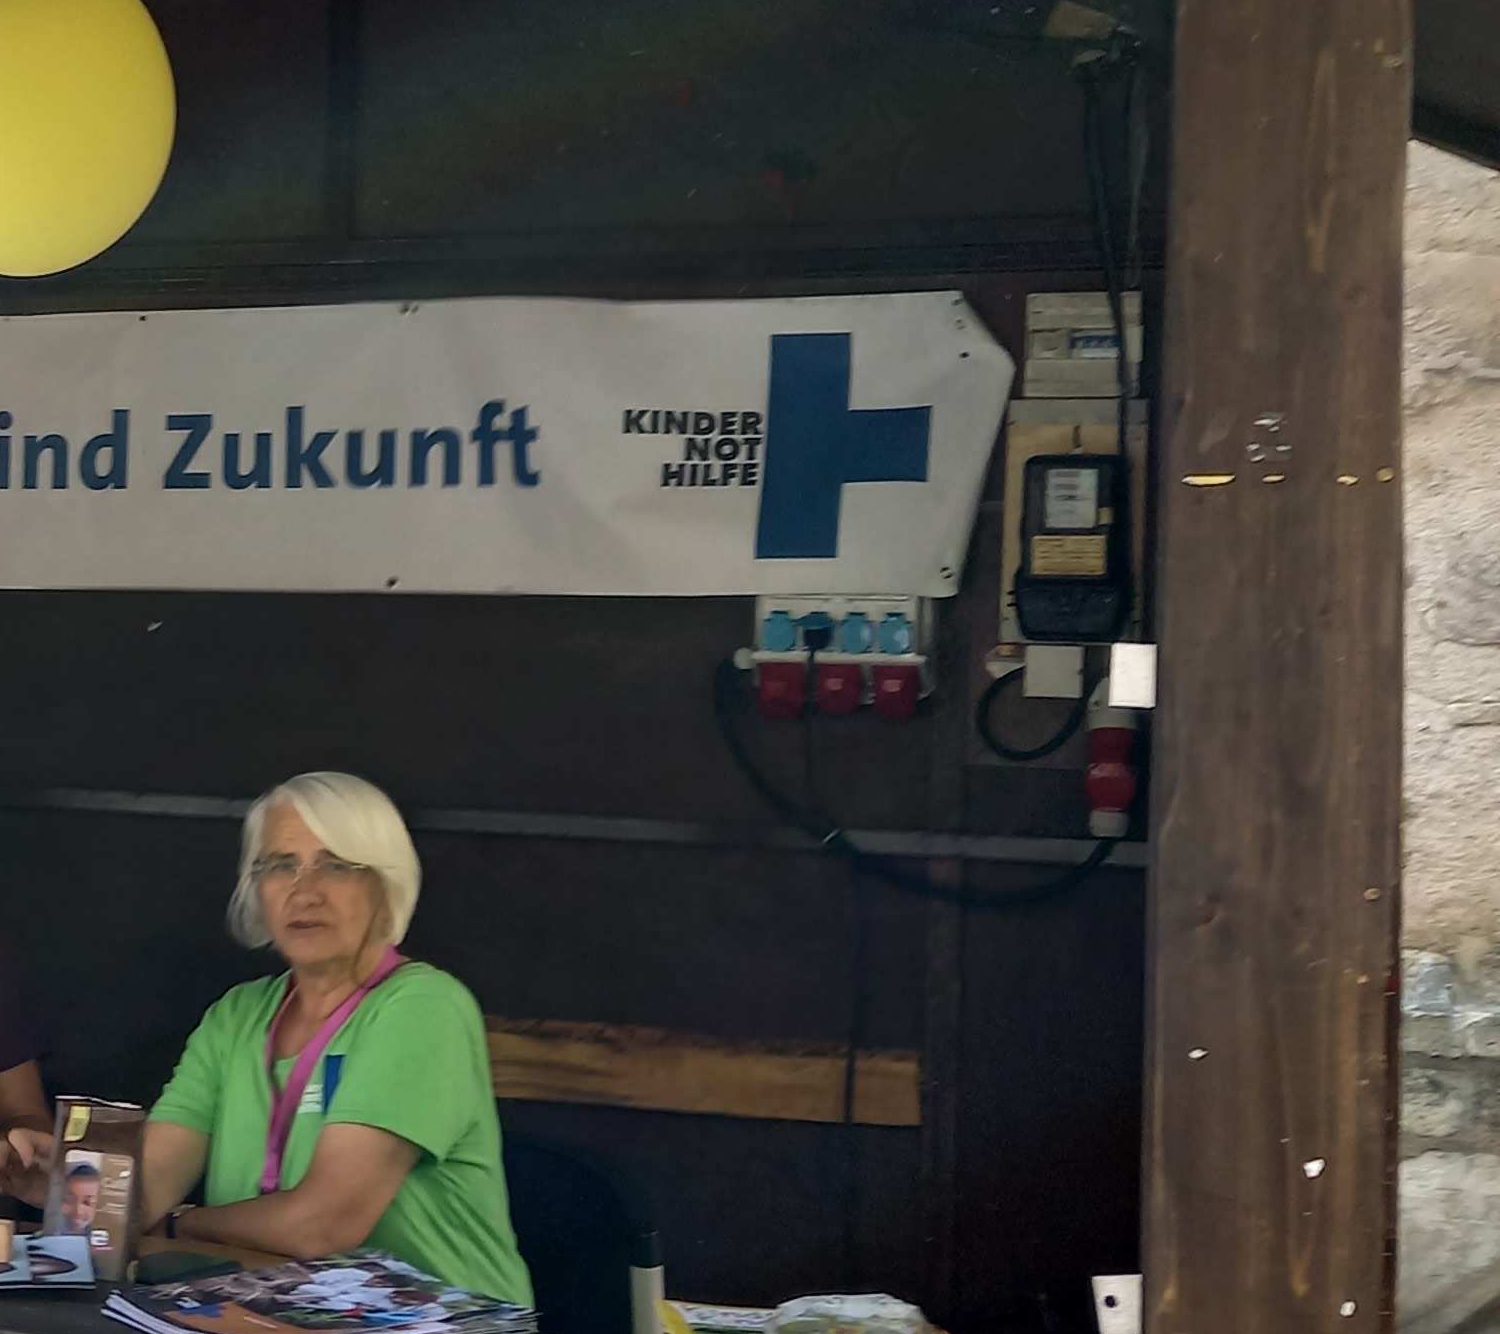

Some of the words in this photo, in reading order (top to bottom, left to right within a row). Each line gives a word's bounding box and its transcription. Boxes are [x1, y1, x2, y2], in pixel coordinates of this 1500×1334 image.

[622, 409, 764, 435] KINDER
[162, 398, 541, 490] Zukunft
[684, 436, 763, 461] NOT
[660, 462, 759, 487] HILFE
